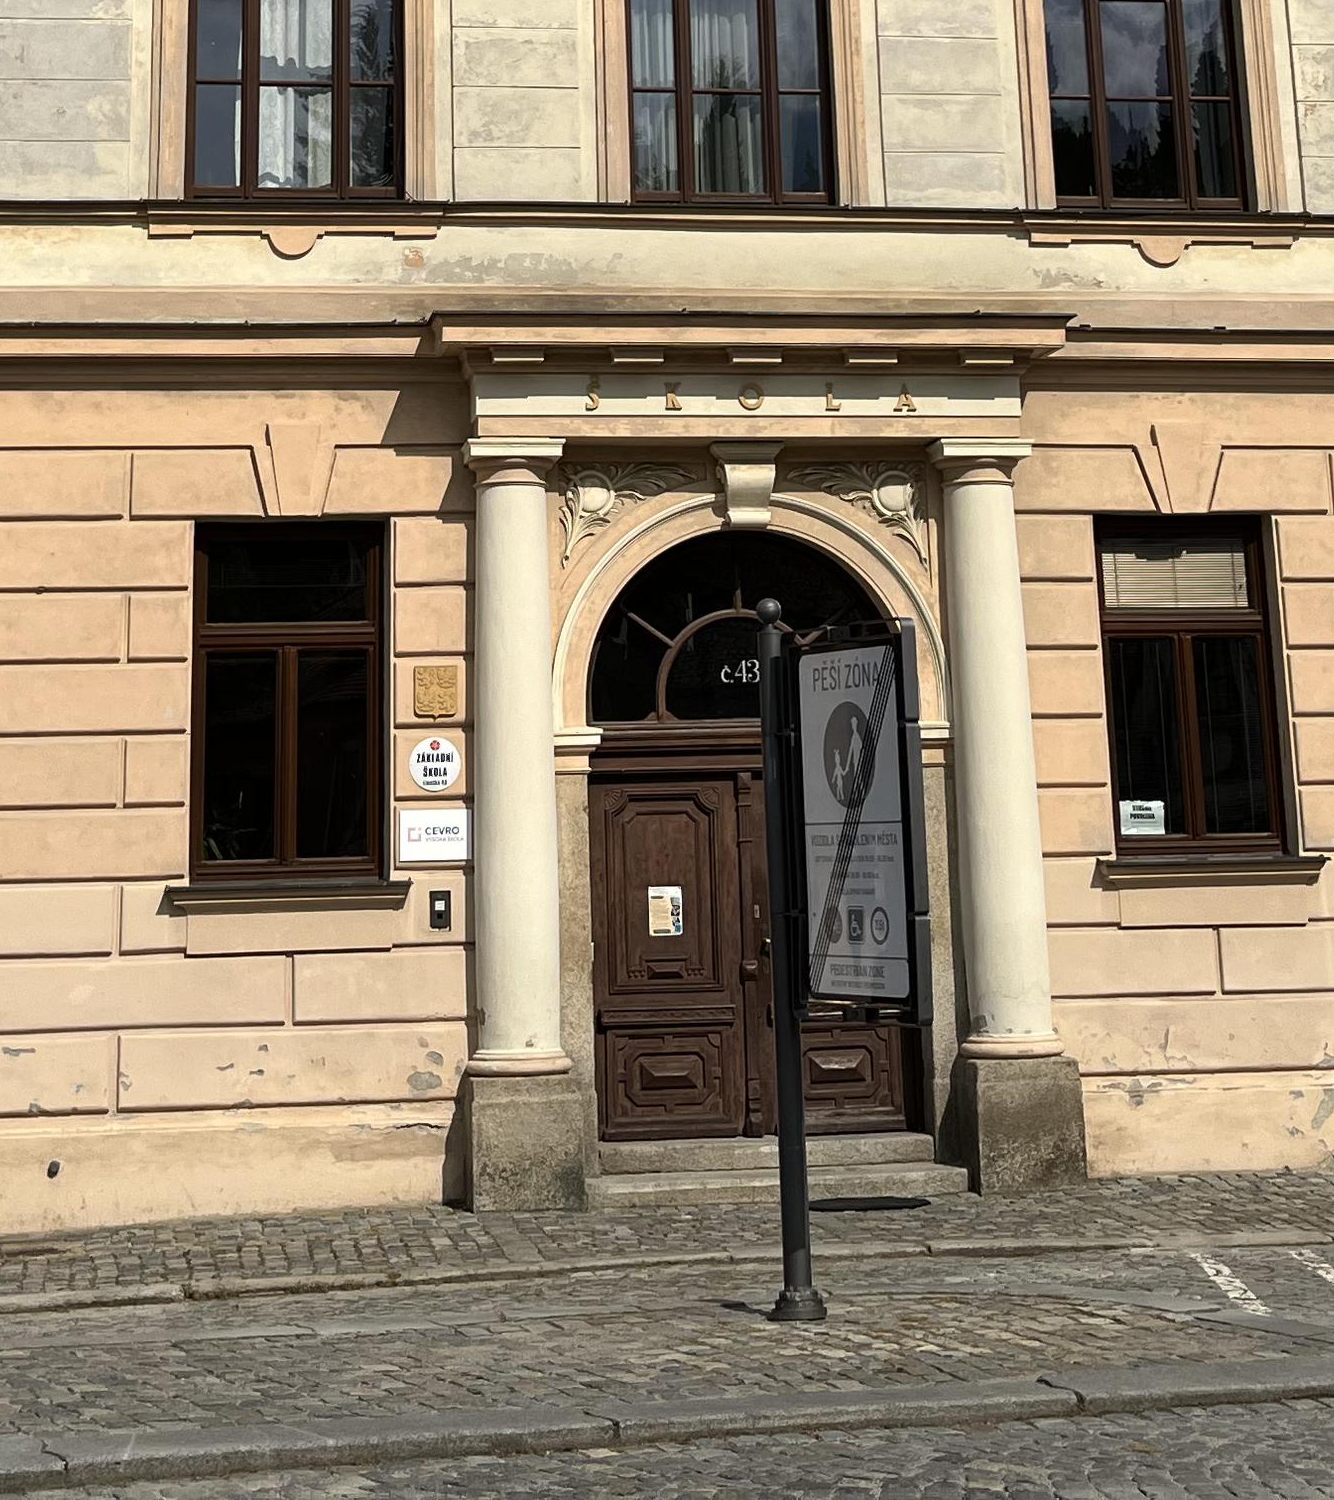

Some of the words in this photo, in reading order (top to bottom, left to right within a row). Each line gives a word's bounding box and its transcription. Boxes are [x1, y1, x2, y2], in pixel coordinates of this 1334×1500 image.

[584, 374, 918, 412] ŠKOLA
[812, 658, 841, 692] PĚŠÍ
[844, 656, 880, 689] ZÓNA
[422, 766, 448, 777] ŠKOLA
[425, 827, 460, 835] CEVRO
